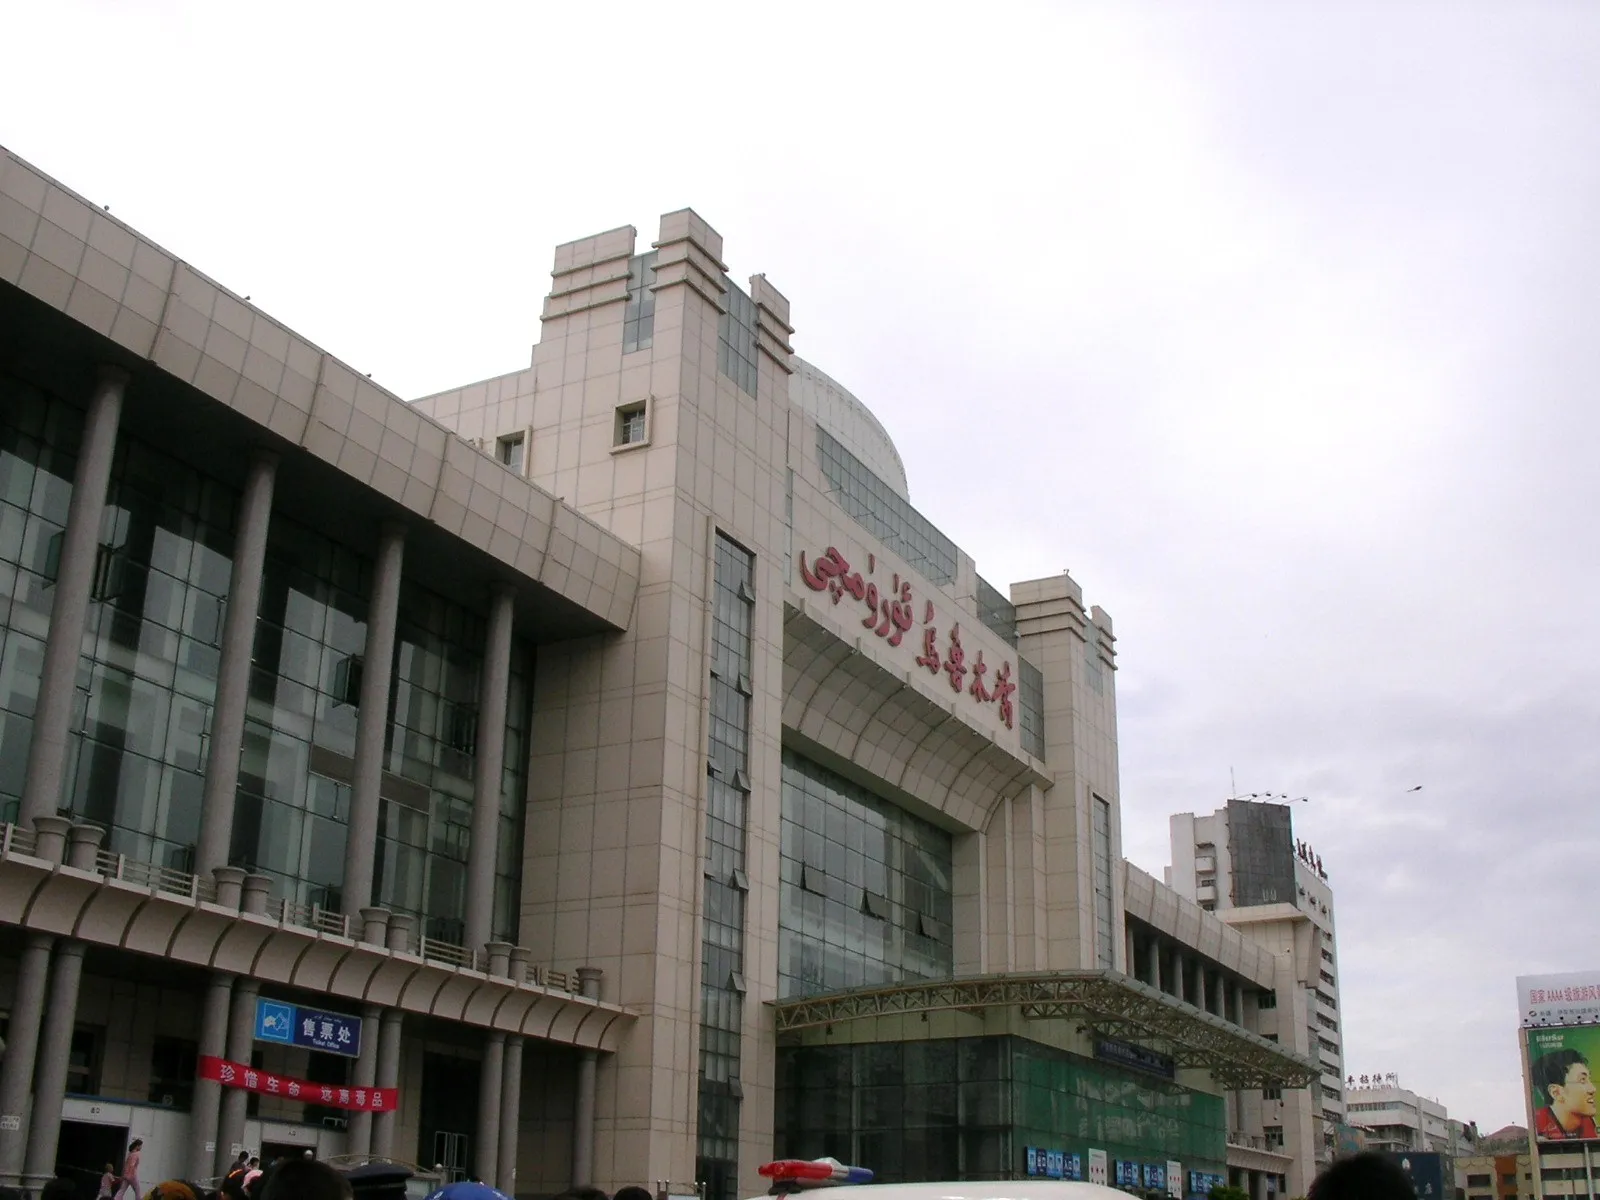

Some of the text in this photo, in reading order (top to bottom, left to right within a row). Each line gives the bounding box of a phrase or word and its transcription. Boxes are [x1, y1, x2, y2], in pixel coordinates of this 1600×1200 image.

[916, 599, 1016, 730] 乌鲁木齐
[302, 1017, 351, 1044] 售票处
[220, 1064, 383, 1108] 珍惜生命 远离毒品
